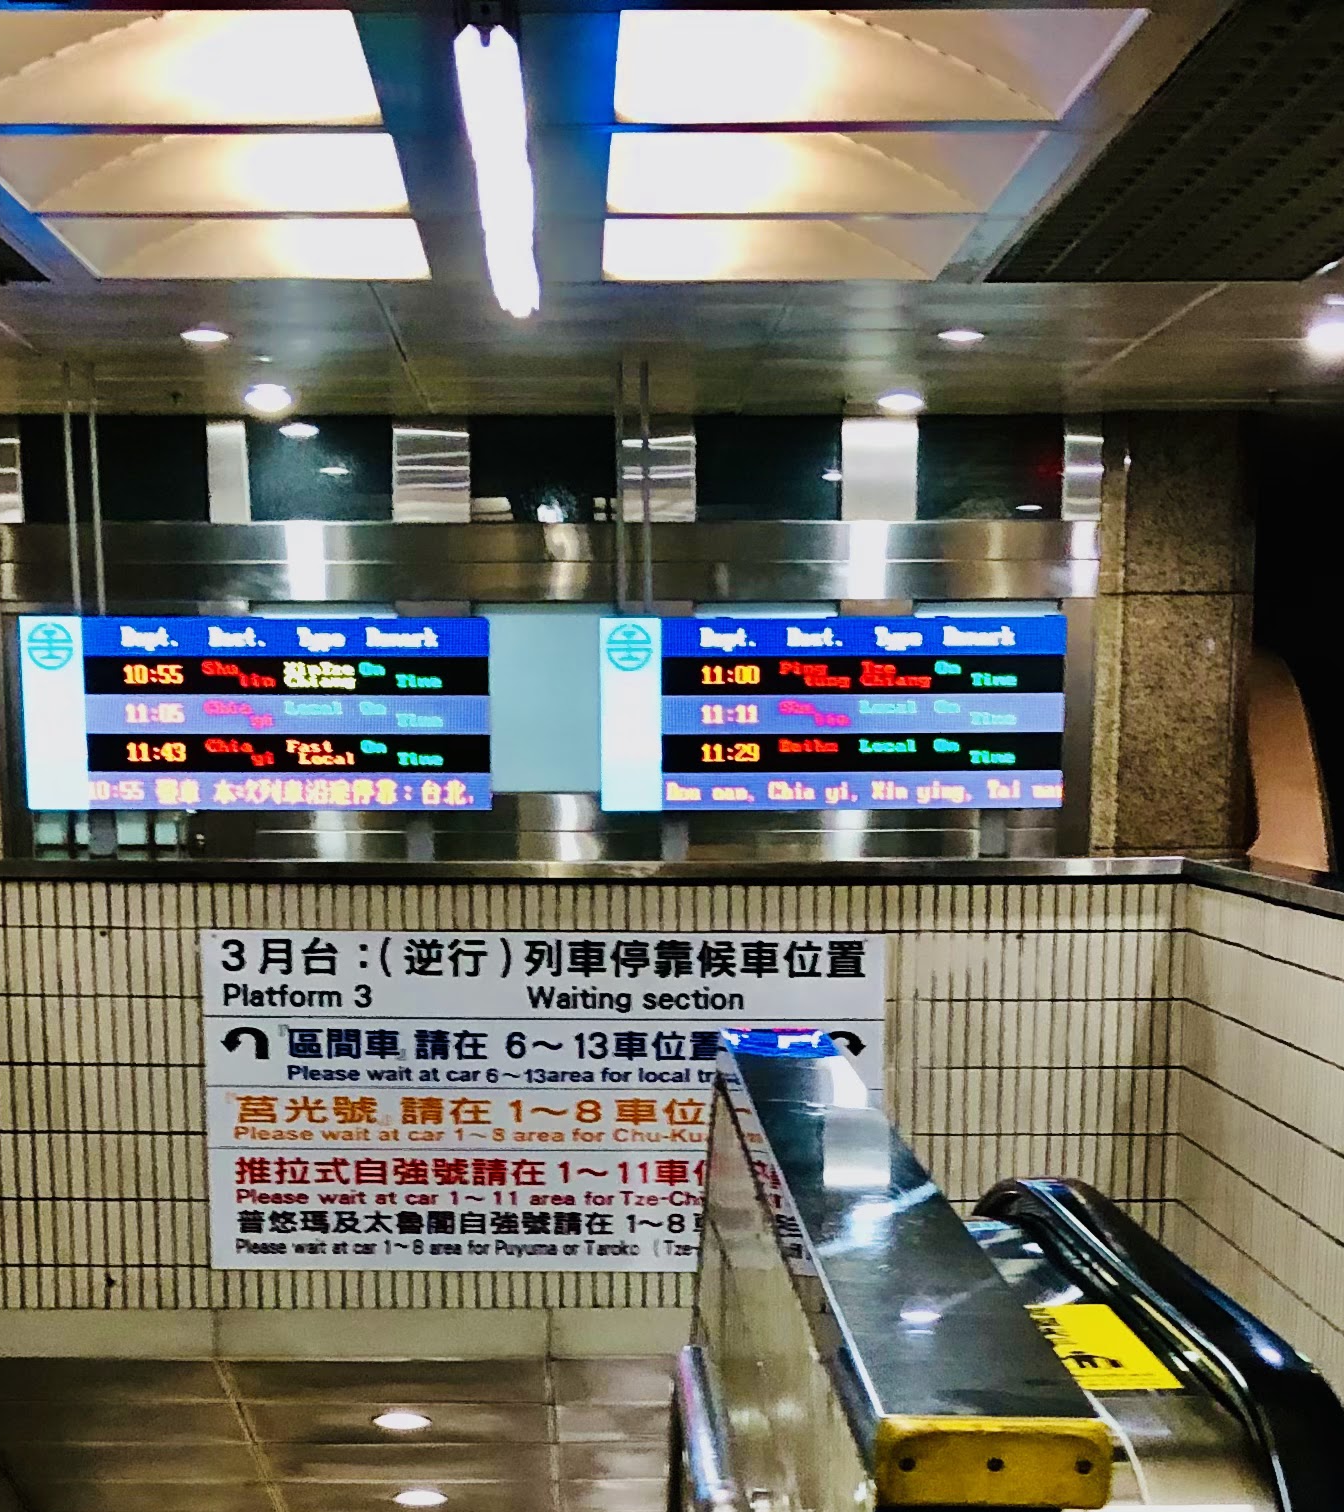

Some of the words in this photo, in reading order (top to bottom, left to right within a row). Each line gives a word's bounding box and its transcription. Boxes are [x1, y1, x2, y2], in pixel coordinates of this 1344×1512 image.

[123, 664, 184, 685] 10:55
[701, 665, 760, 685] 11:00
[700, 703, 759, 724] 11:11
[126, 742, 187, 763] 11:43
[285, 739, 334, 754] Fast
[702, 743, 760, 763] 11:29
[298, 751, 355, 766] Local
[223, 983, 342, 1008] Platform
[354, 984, 372, 1008] 3
[528, 985, 631, 1013] Waiting
[642, 986, 744, 1011] section
[288, 1065, 359, 1082] Please
[367, 1064, 412, 1082] wait
[419, 1066, 439, 1082] at
[446, 1068, 480, 1082] car
[602, 1066, 629, 1083] for
[639, 1067, 690, 1083] local
[234, 1126, 313, 1141] Please
[322, 1126, 371, 1141] wait
[379, 1127, 400, 1141] at
[408, 1129, 444, 1141] car
[513, 1130, 565, 1142] area
[572, 1128, 605, 1142] for
[613, 1128, 703, 1143] Chu-Ku
[236, 1188, 309, 1205] Please
[317, 1189, 367, 1205] wait
[375, 1192, 397, 1205] at
[405, 1193, 439, 1205] car
[529, 1193, 576, 1206] area
[584, 1190, 614, 1206] for
[619, 1190, 704, 1207] Tze-Ch
[236, 1238, 287, 1255] Please
[292, 1239, 327, 1255] wait
[332, 1241, 348, 1255] at
[352, 1243, 377, 1255] car
[429, 1243, 462, 1255] area
[467, 1240, 490, 1255] for
[495, 1240, 557, 1258] Puyuma
[563, 1243, 580, 1255] or
[584, 1240, 640, 1256] Taroko
